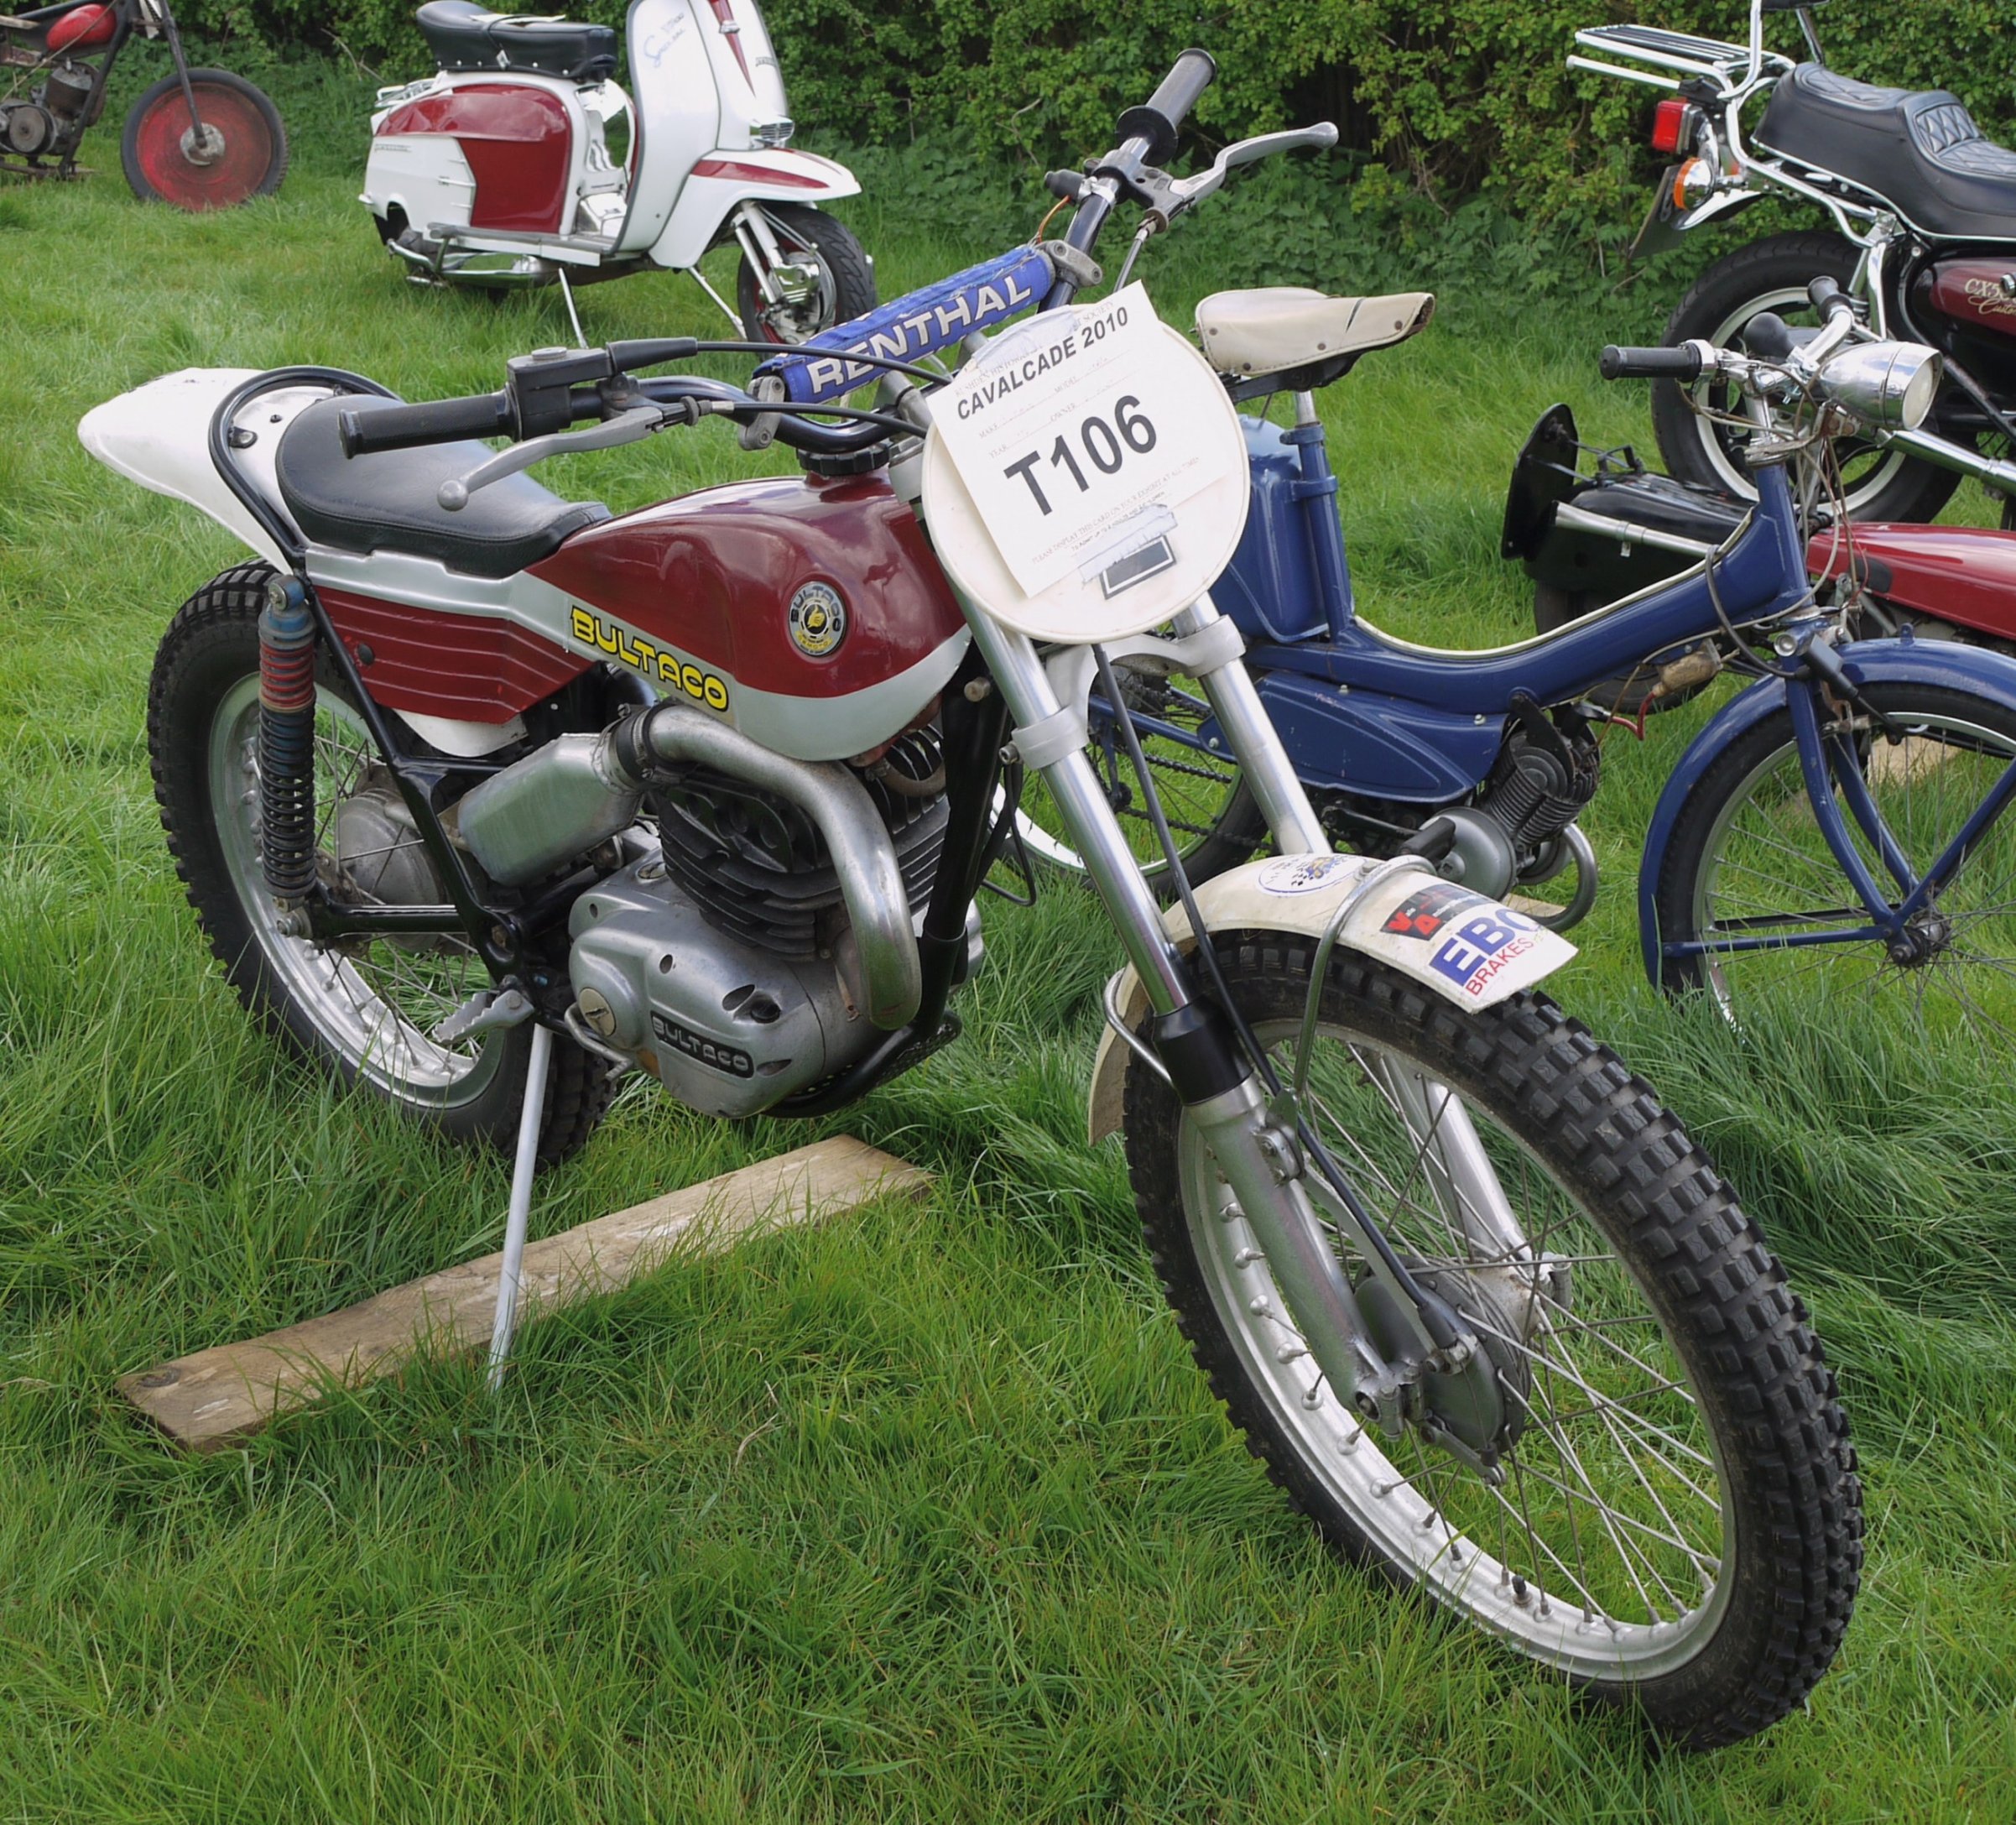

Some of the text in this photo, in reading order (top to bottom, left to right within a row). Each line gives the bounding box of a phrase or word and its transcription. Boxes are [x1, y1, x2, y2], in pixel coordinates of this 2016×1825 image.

[1082, 300, 1114, 326] SOCIETY
[1964, 278, 2016, 304] CX5
[806, 276, 1032, 394] RENTHAL
[957, 306, 1128, 420] CAVALCADE 2010
[978, 423, 999, 440] MAKE
[1054, 375, 1078, 394] MODEL
[988, 444, 1008, 459] YEAR
[1050, 402, 1077, 422] OWNER
[1003, 395, 1157, 516] T106
[790, 585, 841, 632] BULTACO
[570, 605, 729, 712] BULTACO
[1429, 909, 1539, 988] EBC
[1466, 937, 1534, 997] BRAKES
[652, 1015, 749, 1072] BULTACO
